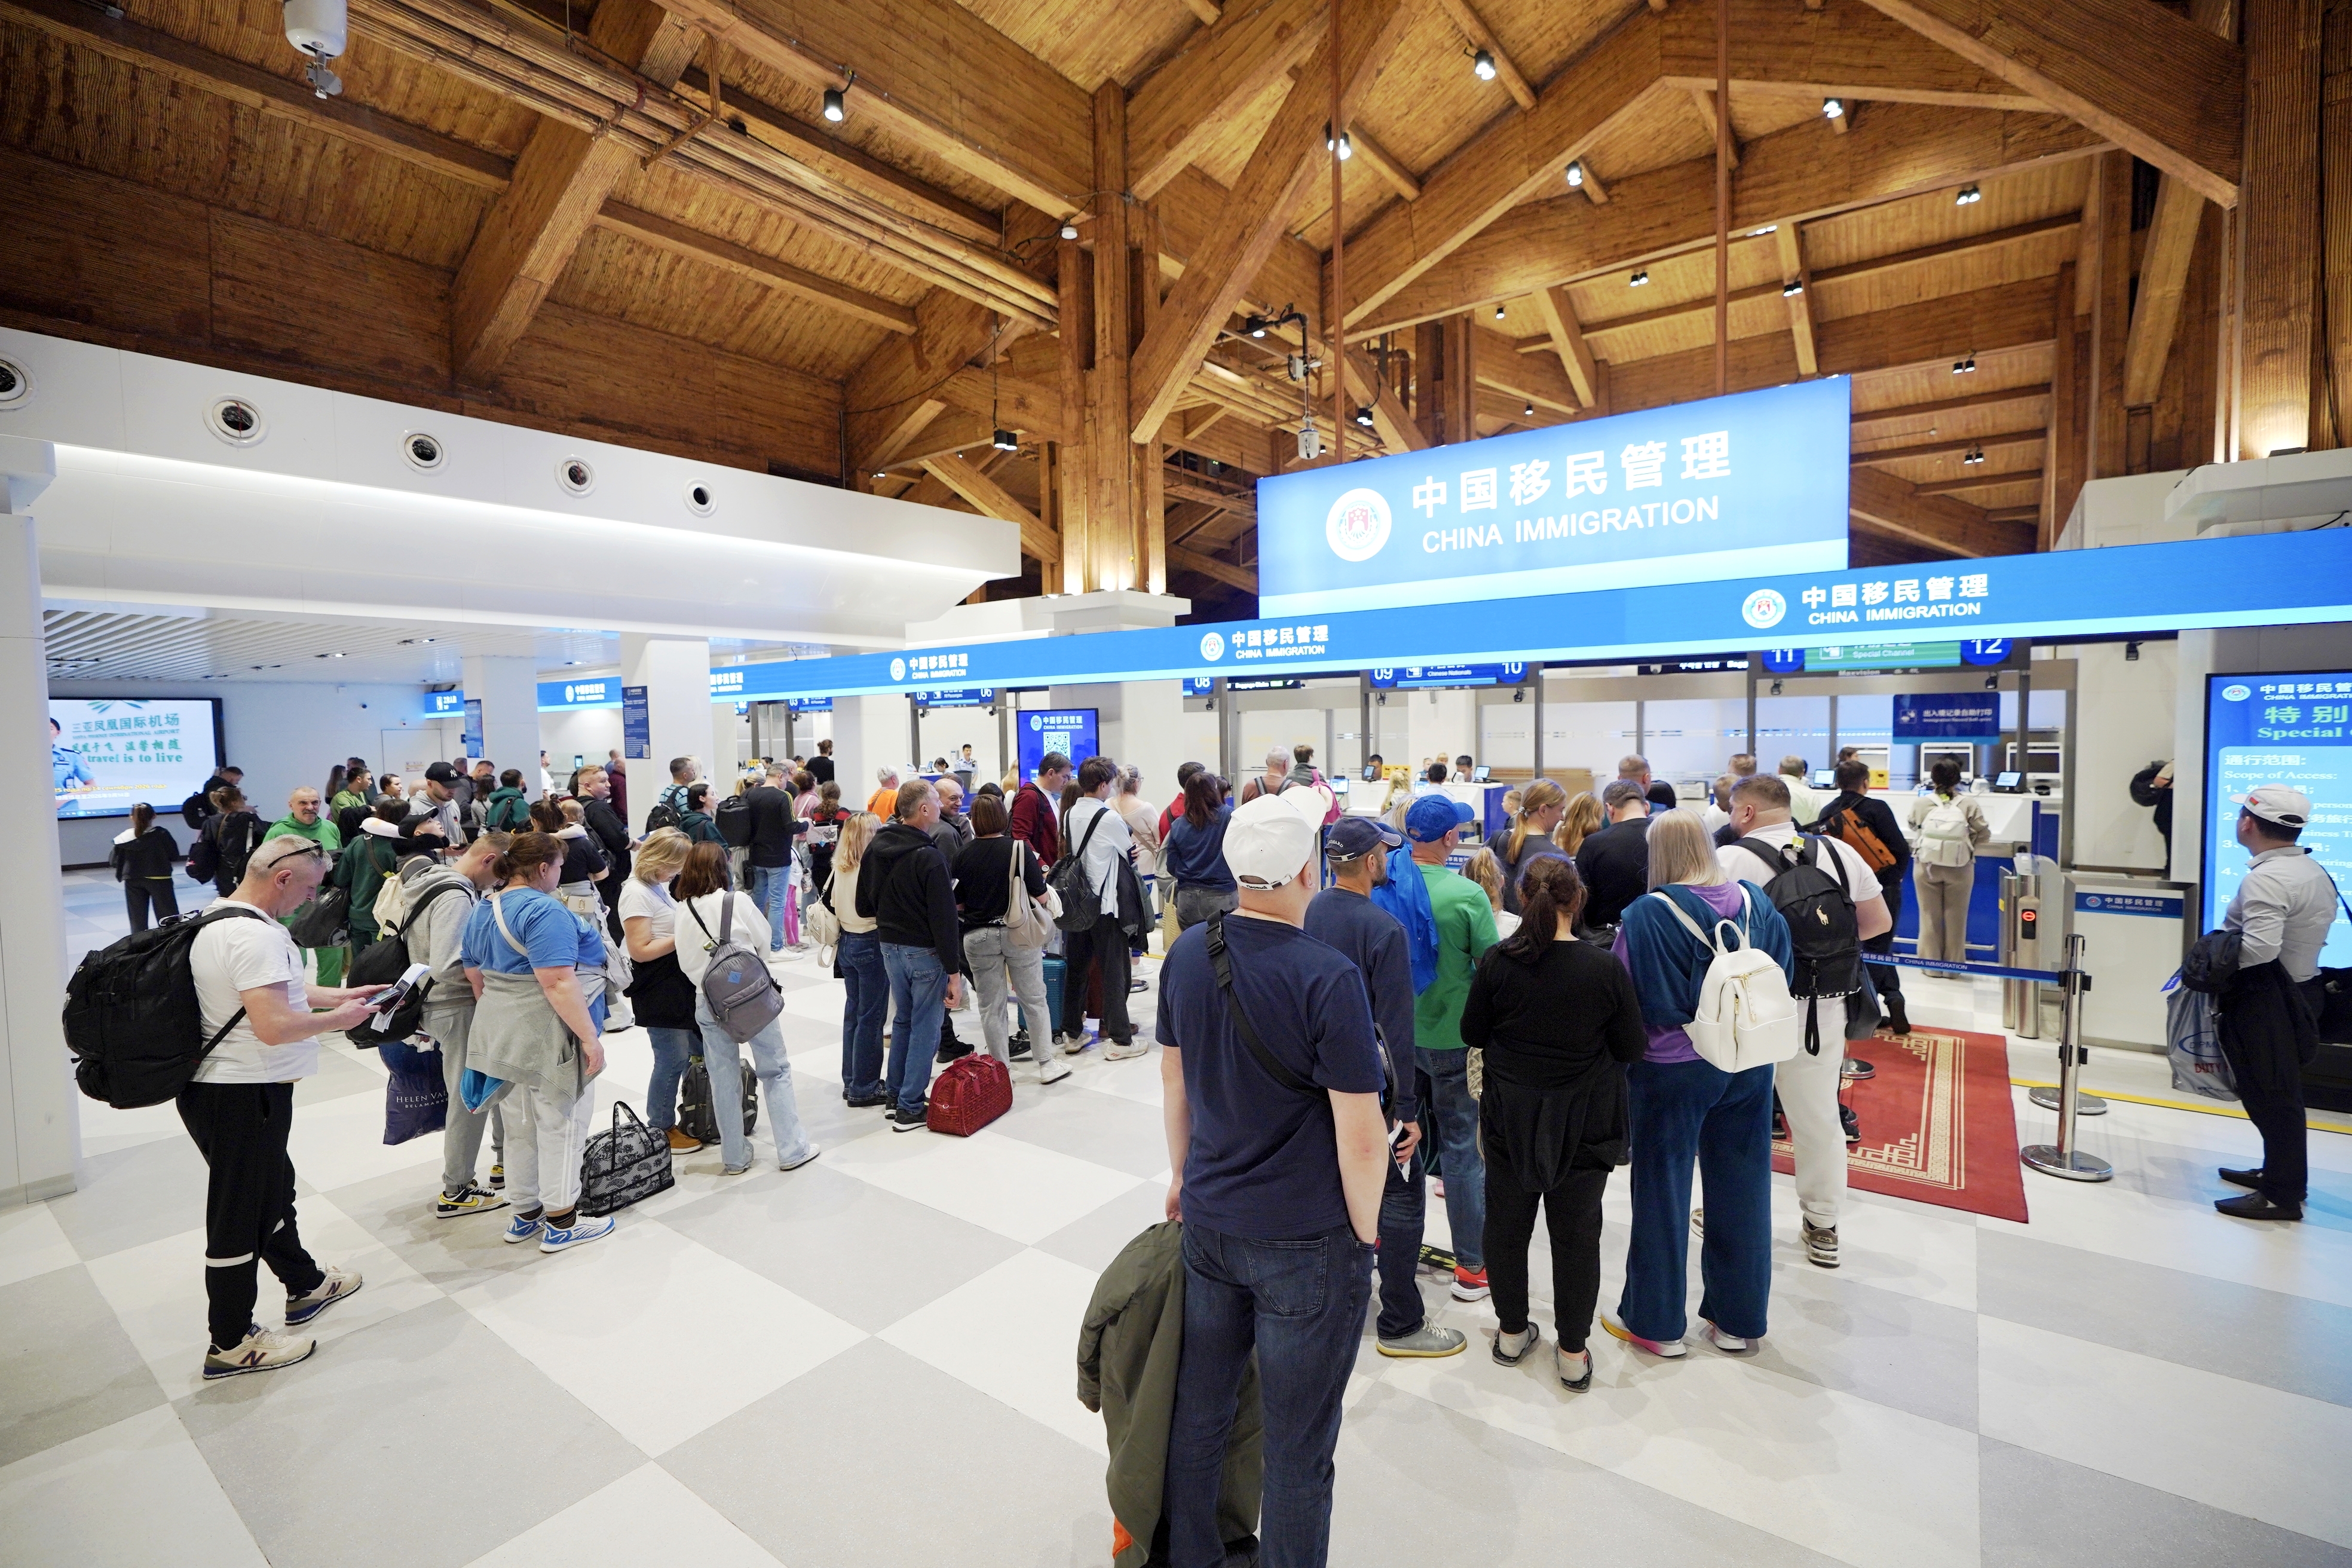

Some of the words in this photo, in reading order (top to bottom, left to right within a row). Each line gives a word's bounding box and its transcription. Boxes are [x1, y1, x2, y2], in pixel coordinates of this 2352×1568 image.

[1412, 430, 1731, 519] 中国移民管理
[1422, 523, 1504, 554] CHINA
[1515, 495, 1719, 544] IMMIGRATION
[1802, 574, 1988, 609] 中国移民管理
[1808, 610, 1858, 625] CHINA
[1866, 602, 1981, 621] IMMIGRATION
[1232, 624, 1329, 648] 中国移民管理
[1236, 649, 1263, 659] CHINA
[1266, 645, 1325, 657] IMMIGRATION
[1852, 650, 1881, 659] Special
[1881, 649, 1915, 657] Channel
[909, 653, 969, 670] 中国移民管理
[912, 671, 929, 679] CHINA
[930, 669, 967, 678] IMMIGRATION
[1374, 668, 1394, 680] 09
[1043, 715, 1083, 724] 中国移民管理
[2264, 705, 2348, 724] 特别
[72, 713, 179, 733] 三亚凤凰国际机场
[2258, 727, 2342, 740] Special
[87, 754, 119, 762] travel
[123, 754, 133, 762] is
[139, 754, 151, 762] to
[155, 752, 183, 762] live
[2224, 771, 2264, 780] Scope
[2267, 771, 2285, 779] of
[2285, 771, 2338, 780] Access:
[2104, 897, 2163, 907] 中国移民管理
[1860, 953, 1900, 963] 国移民管理
[1925, 961, 1968, 970] IMMIGRATION
[2195, 1063, 2221, 1073] DUTY
[396, 1095, 428, 1103] HELEN
[430, 1090, 448, 1099] VAL
[405, 1097, 448, 1108] BELAMARKE
